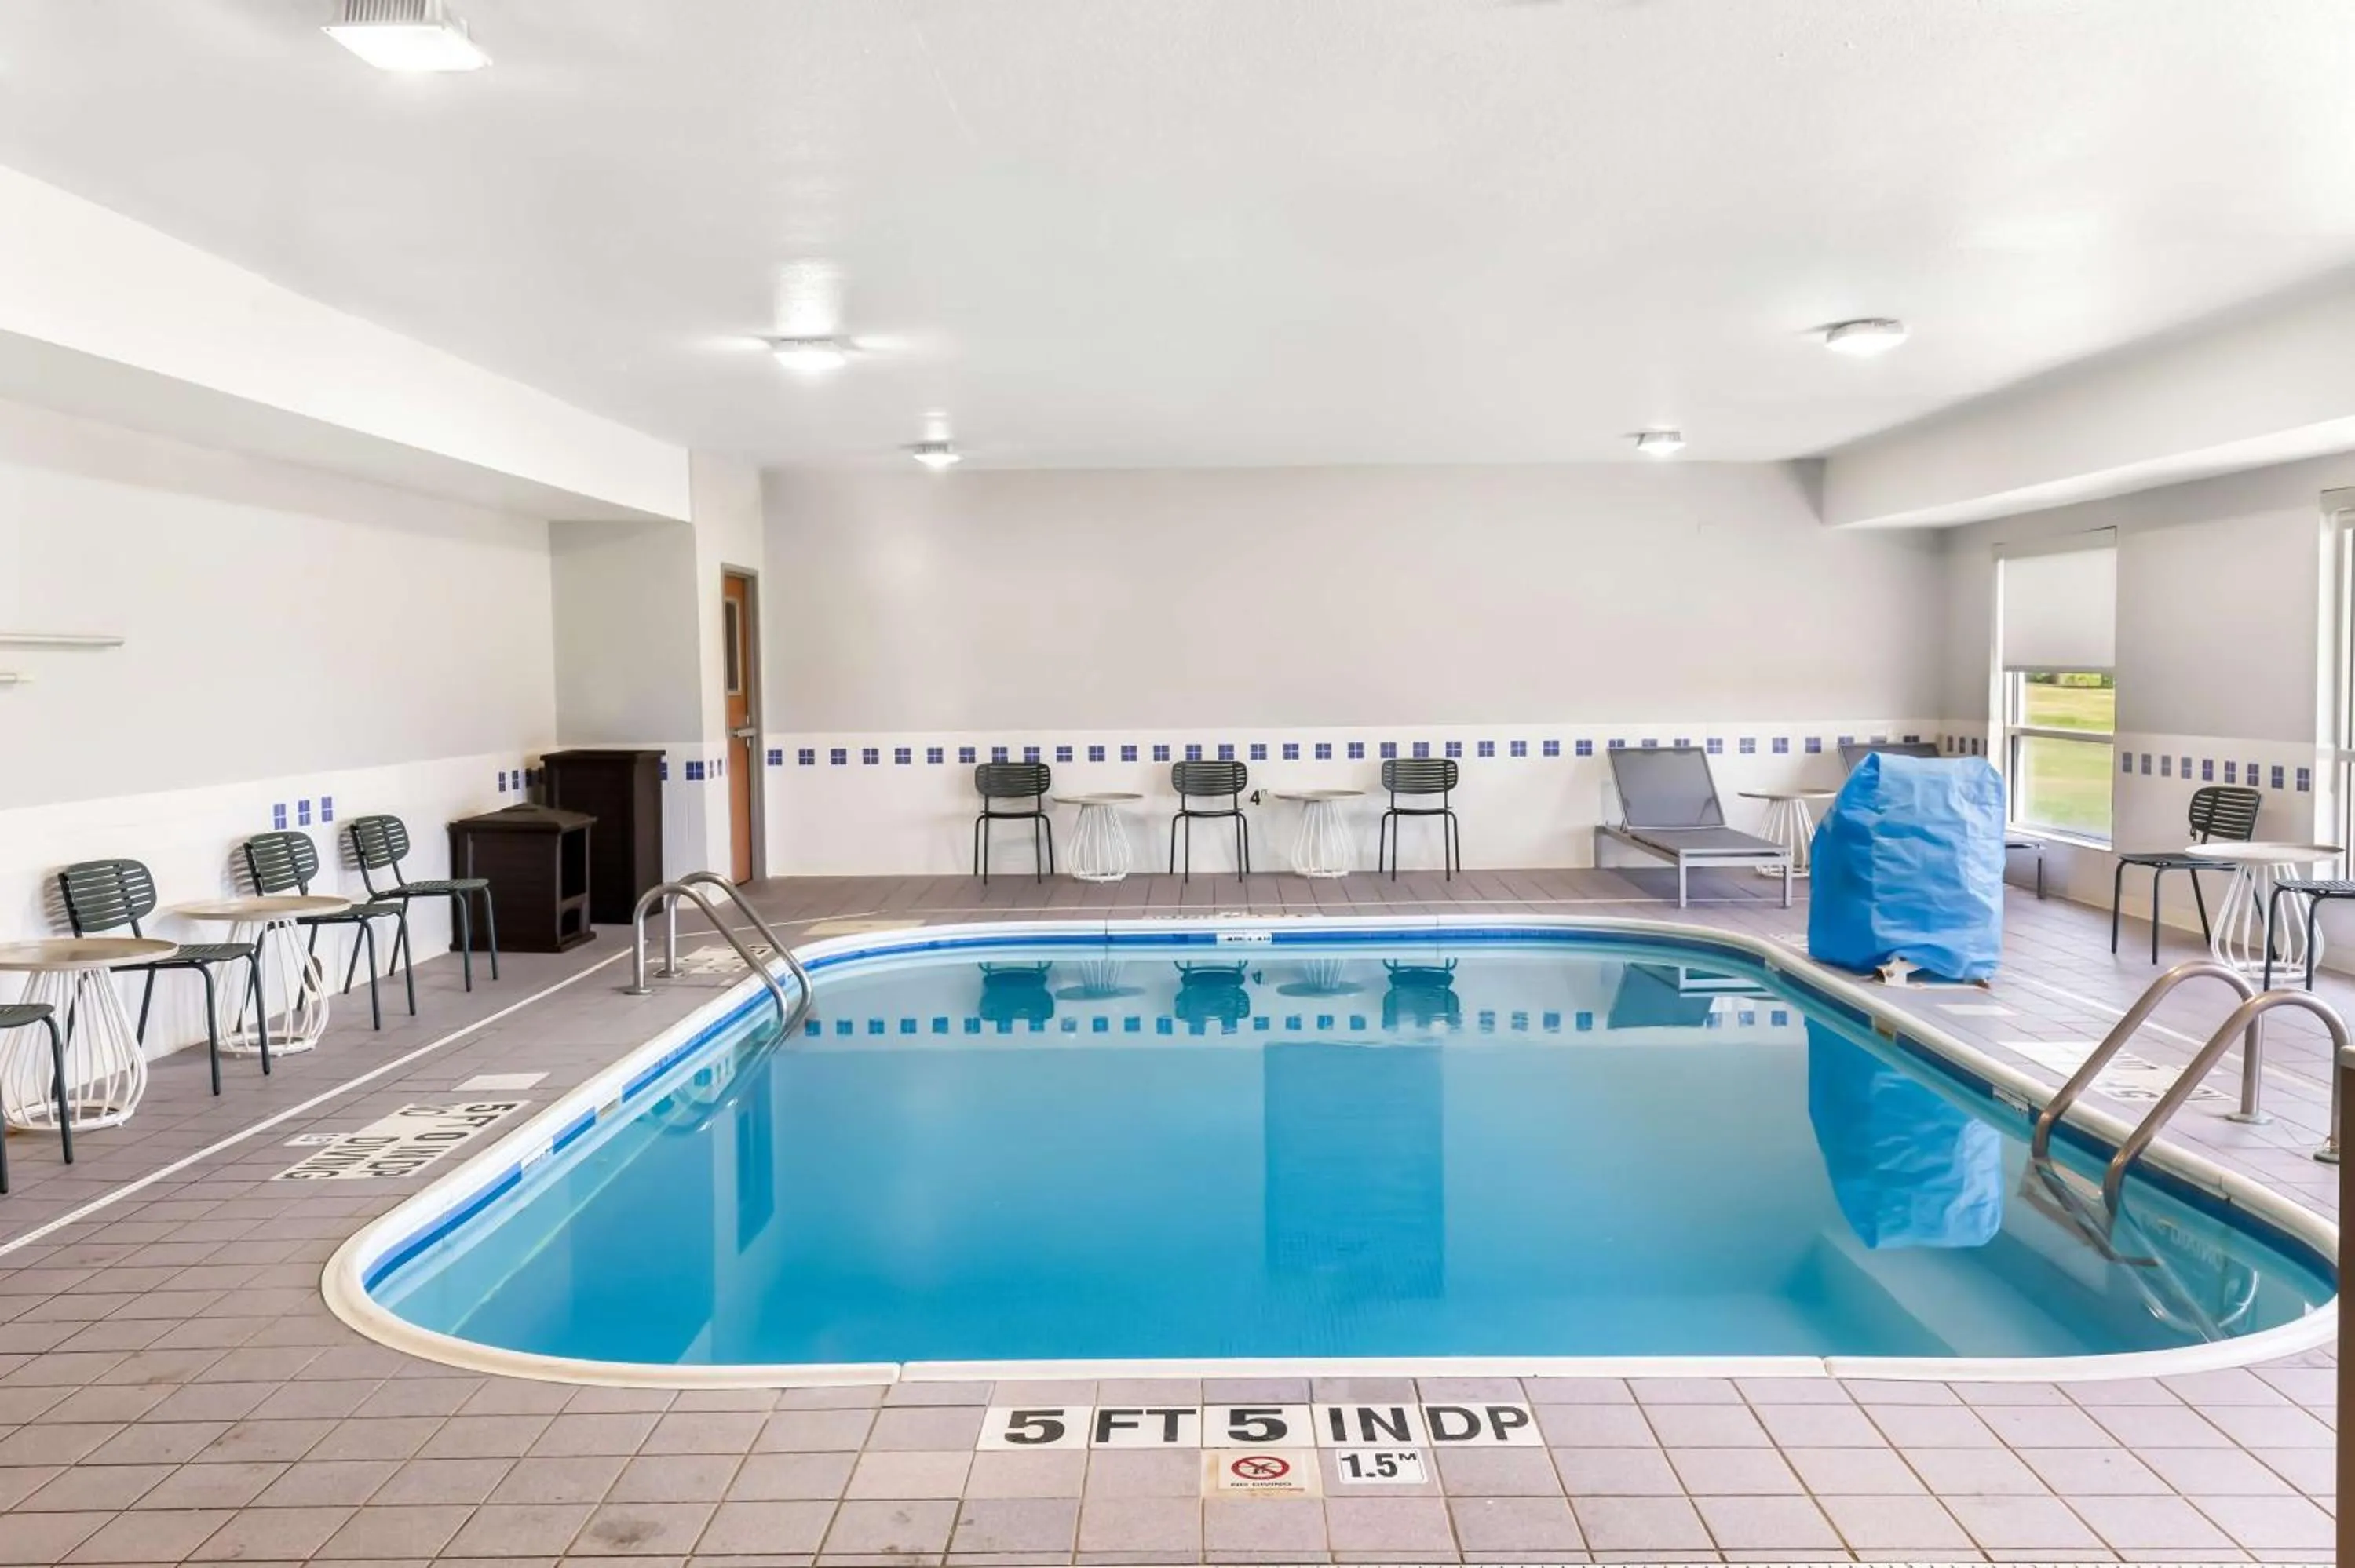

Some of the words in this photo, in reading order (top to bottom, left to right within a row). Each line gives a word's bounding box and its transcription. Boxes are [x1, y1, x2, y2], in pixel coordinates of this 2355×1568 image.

[281, 1137, 400, 1179] DIVING
[1004, 1409, 1065, 1445] 5
[1095, 1409, 1197, 1443] FT
[1227, 1409, 1288, 1442] 5
[1328, 1407, 1411, 1442] IN
[1426, 1406, 1528, 1441] DP
